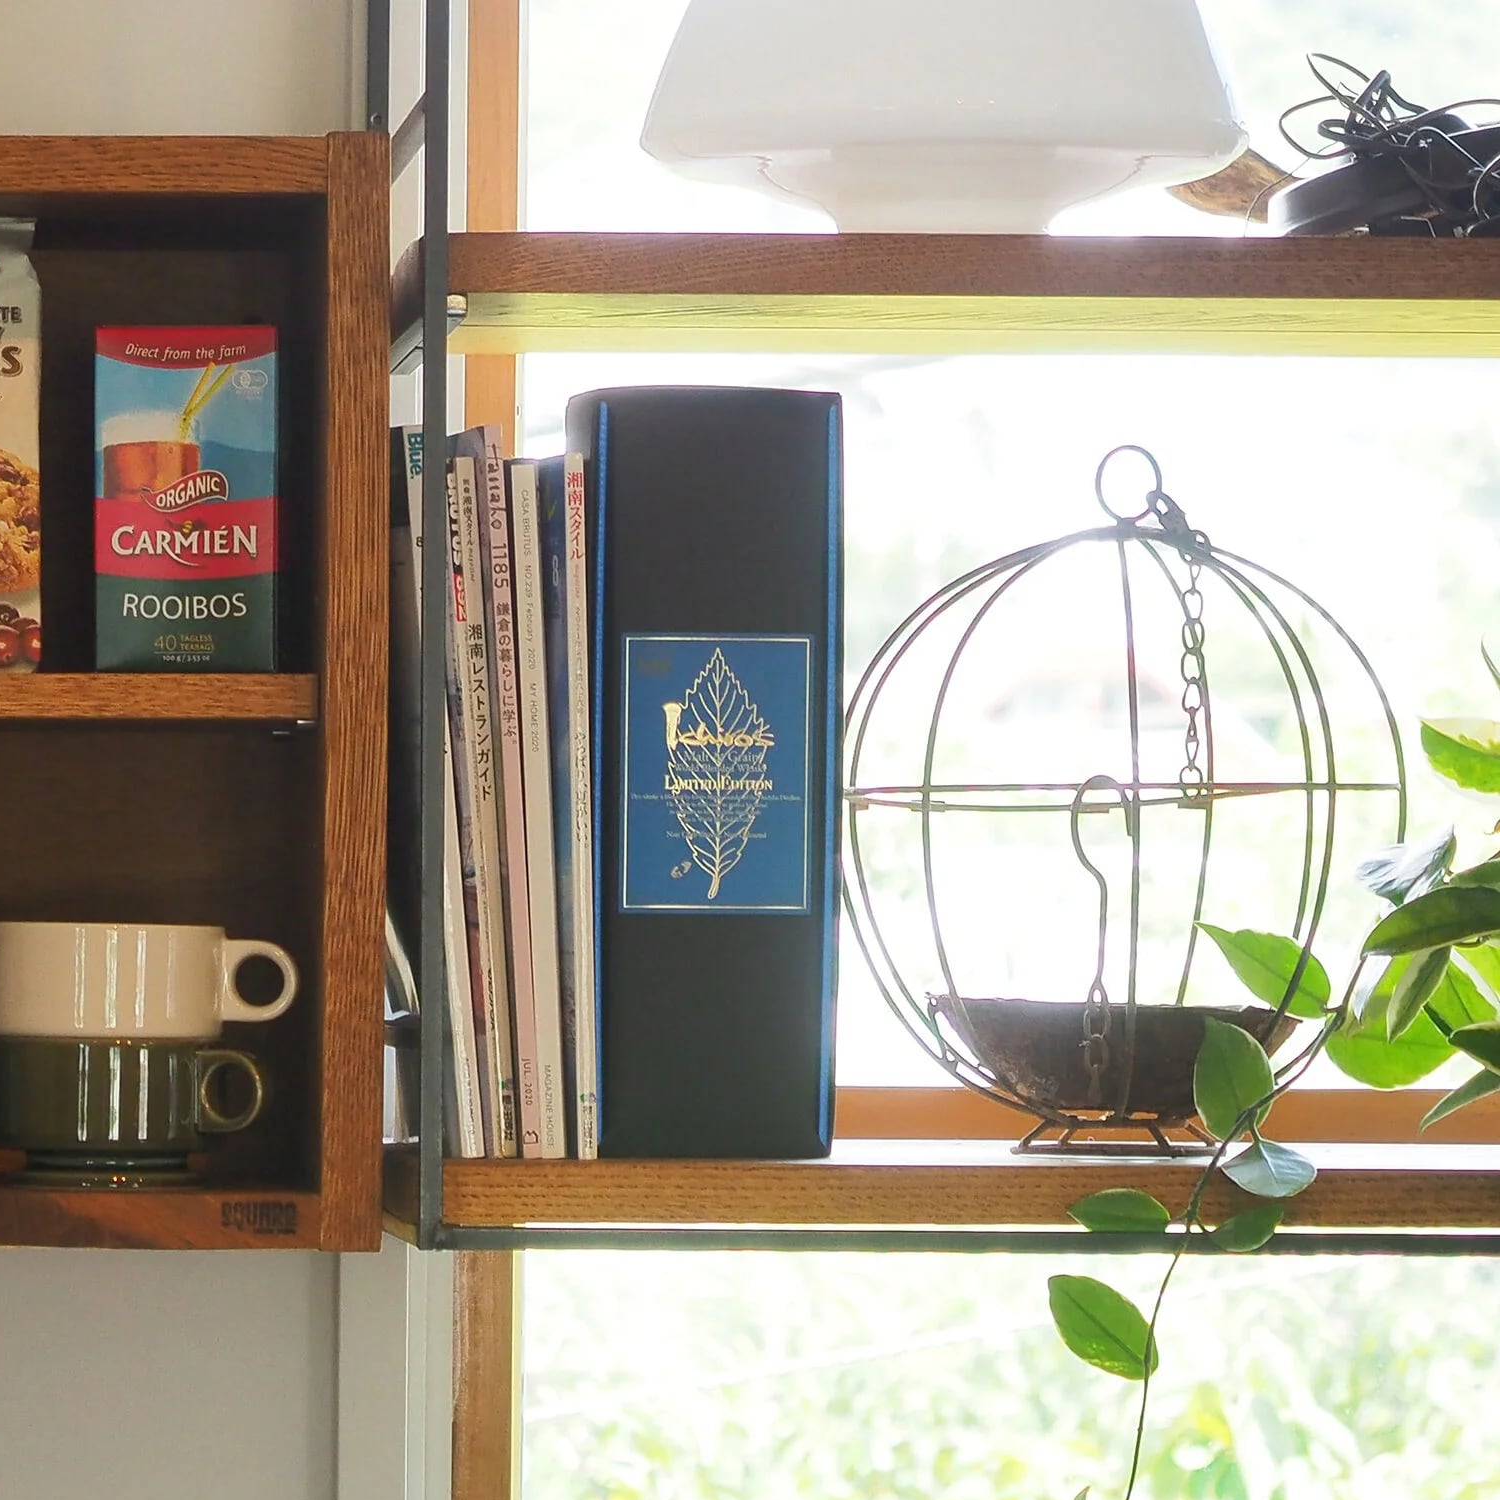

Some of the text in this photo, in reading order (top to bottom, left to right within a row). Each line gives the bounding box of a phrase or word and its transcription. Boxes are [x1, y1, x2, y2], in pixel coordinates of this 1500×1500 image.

[125, 343, 246, 361] Direct from the farm
[156, 475, 221, 508] ORGANIC
[521, 489, 529, 516] CASA
[567, 471, 585, 561] 湘南スタイル
[111, 524, 258, 566] CARMIÉN
[522, 518, 532, 556] BRUTUS
[492, 543, 508, 589] 1185
[123, 593, 247, 620] ROOIBOS
[154, 634, 177, 651] 40
[468, 623, 492, 802] 湘南レストランガイド
[720, 774, 773, 792] EDITION
[524, 1083, 534, 1106] 2020
[544, 1065, 554, 1113] MAGAZINE
